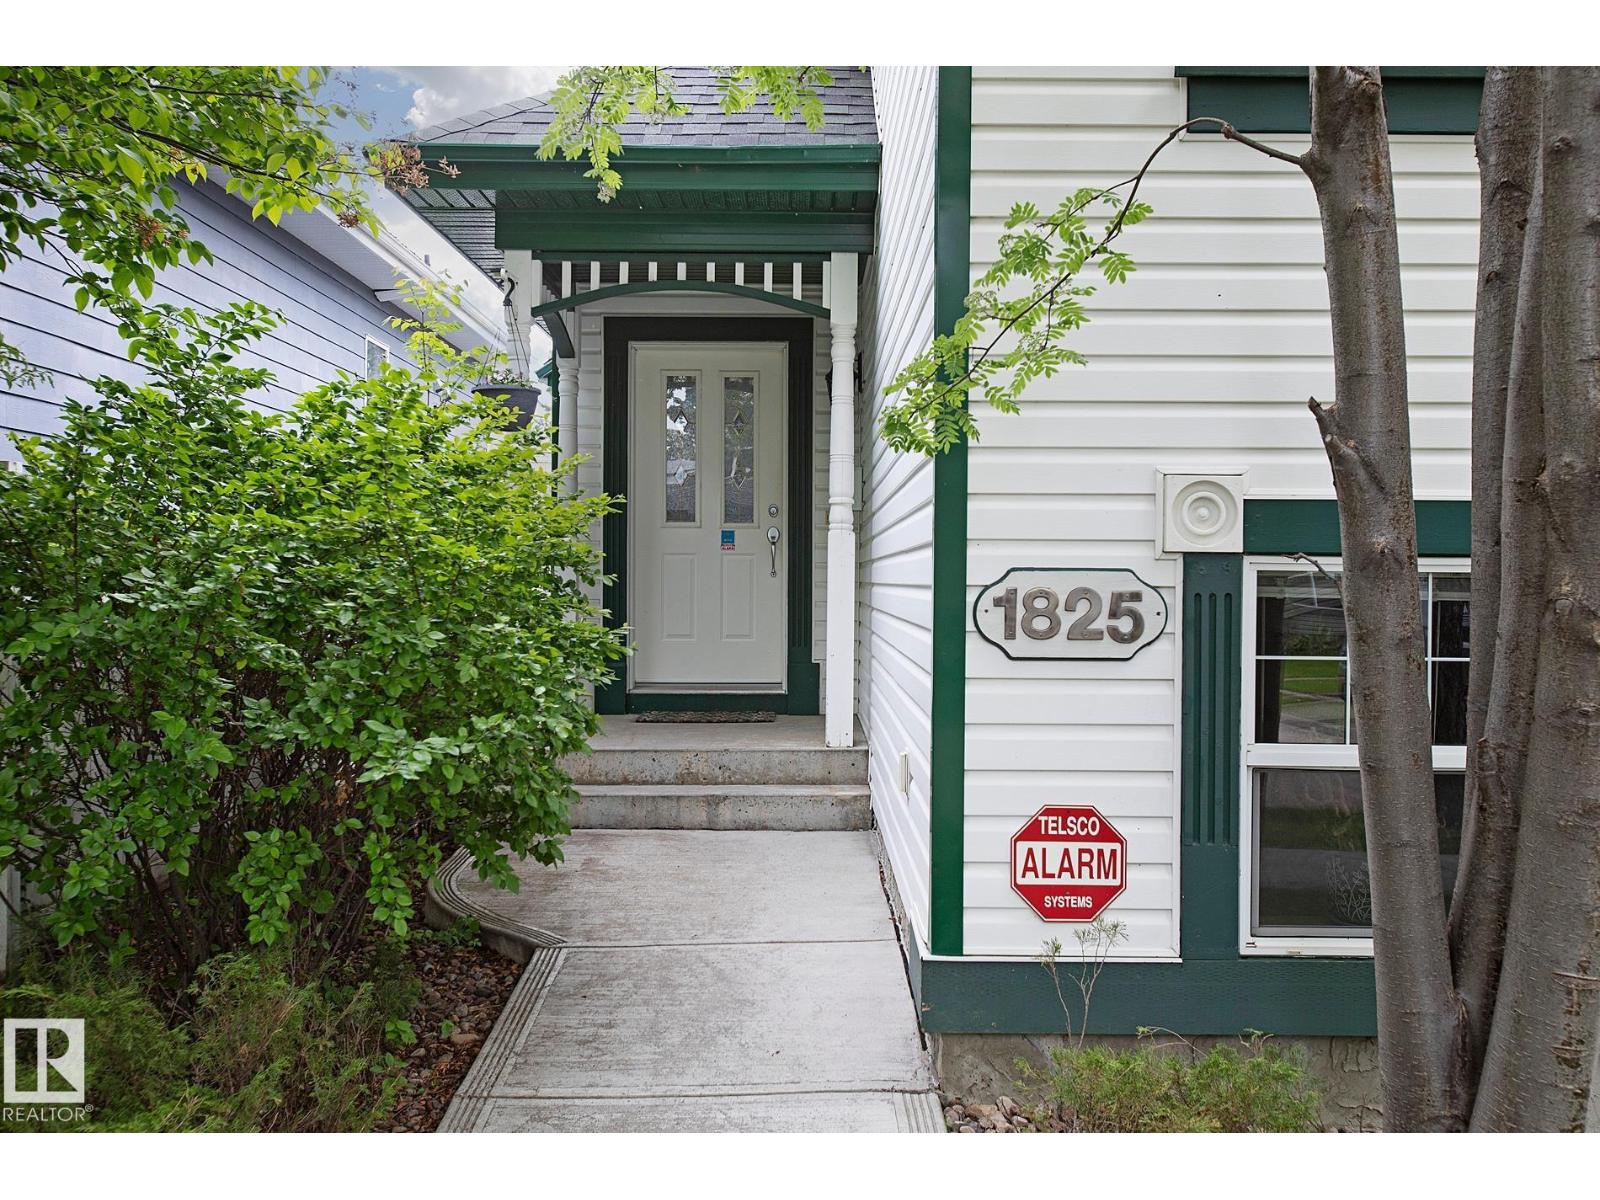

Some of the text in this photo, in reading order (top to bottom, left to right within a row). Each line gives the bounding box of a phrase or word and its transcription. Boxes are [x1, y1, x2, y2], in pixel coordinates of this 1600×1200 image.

[993, 586, 1145, 644] 1825
[1038, 815, 1100, 836] TELSCO
[1021, 847, 1118, 880] ALARM
[1043, 895, 1093, 908] SYSTEMS
